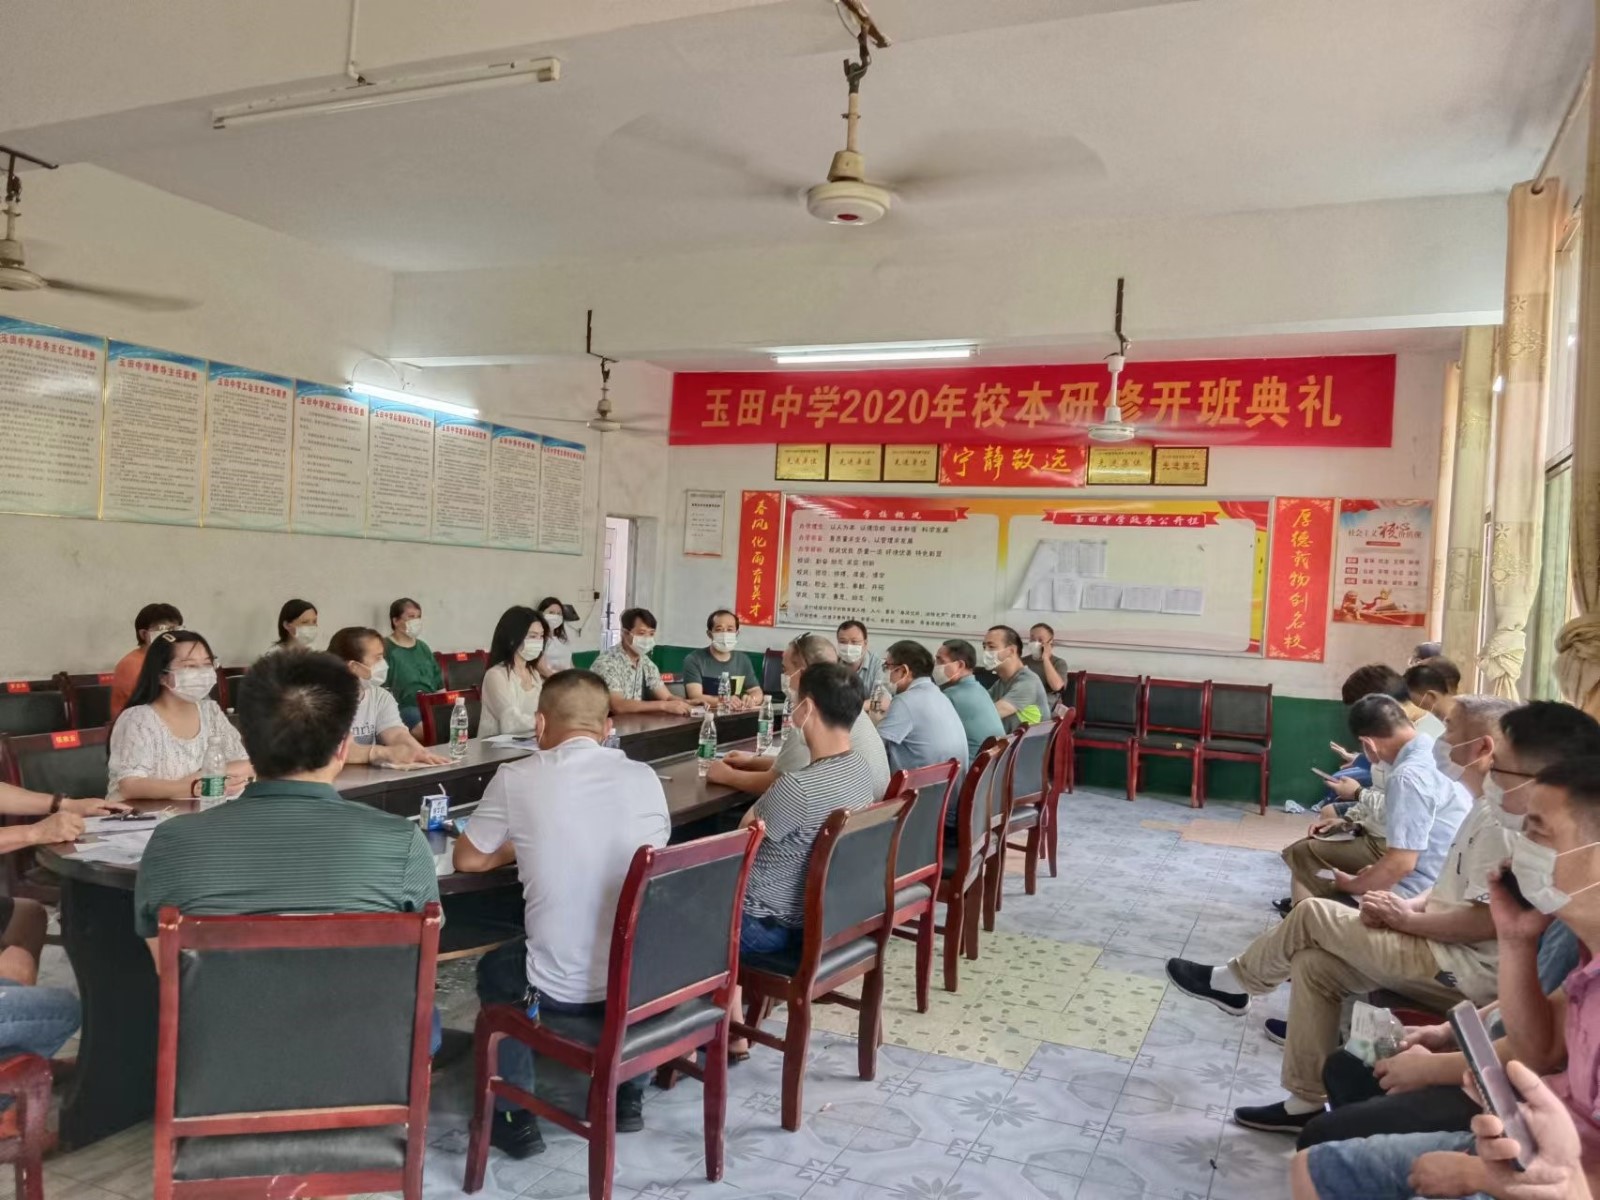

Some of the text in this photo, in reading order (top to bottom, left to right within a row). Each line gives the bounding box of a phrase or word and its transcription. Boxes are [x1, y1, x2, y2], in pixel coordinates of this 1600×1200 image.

[700, 374, 1343, 430] 玉田中学2020年校本研修开班典礼
[952, 445, 1072, 481] 宁静致远
[749, 498, 769, 618] 春风化雨育英才
[1283, 508, 1315, 650] 厚德载物创名校
